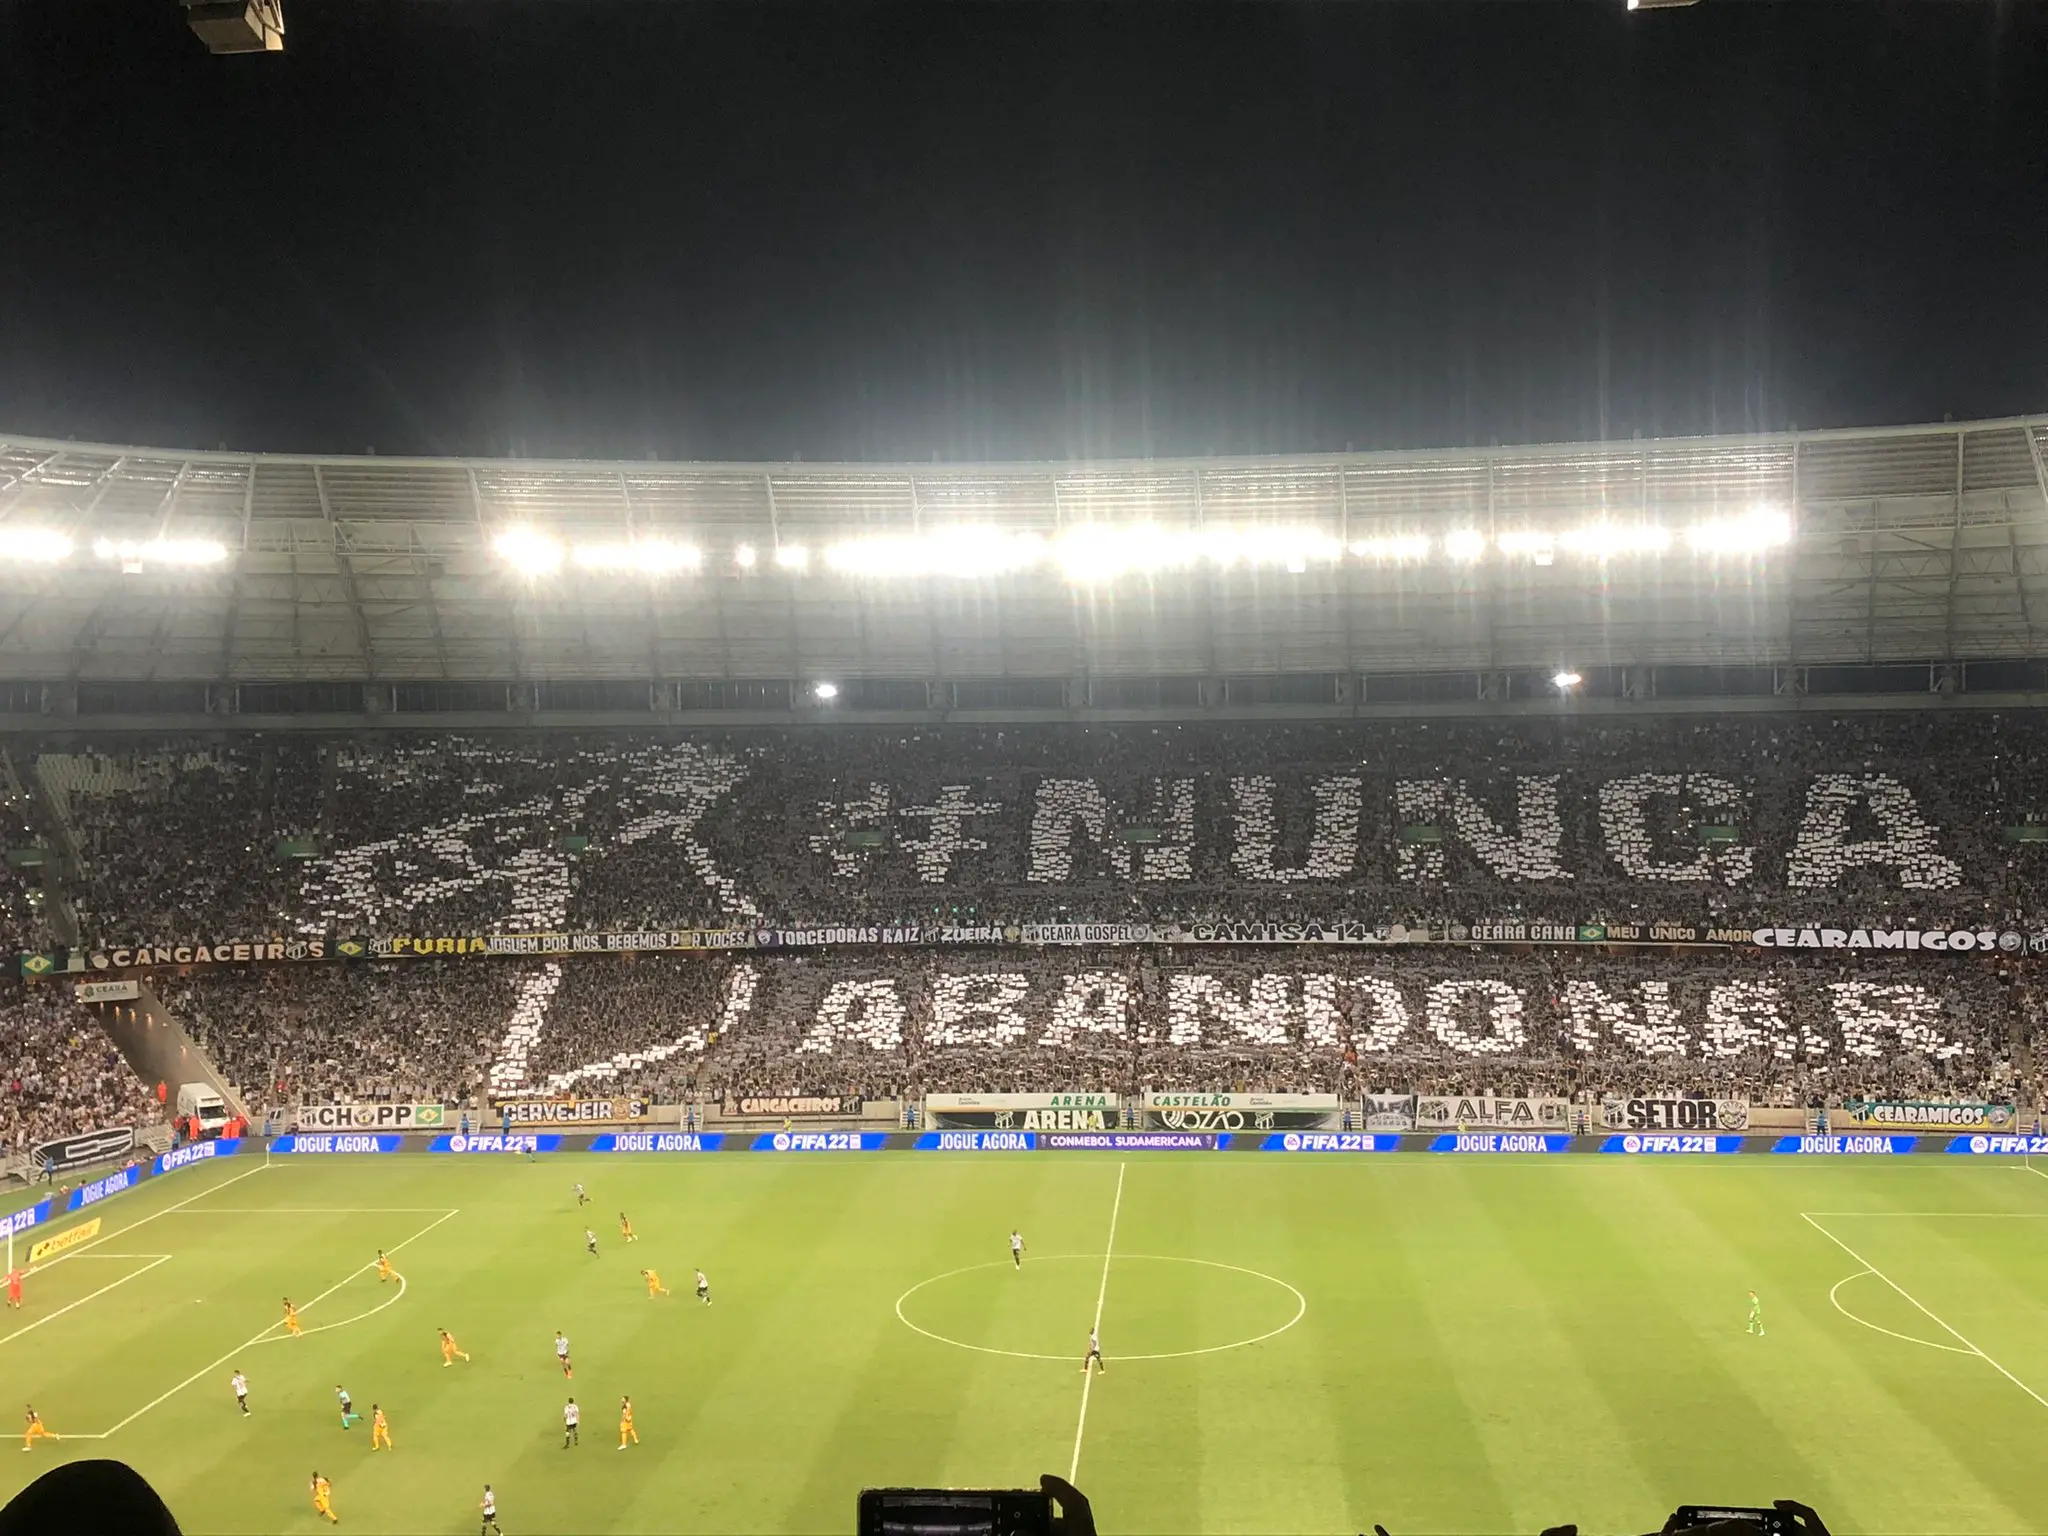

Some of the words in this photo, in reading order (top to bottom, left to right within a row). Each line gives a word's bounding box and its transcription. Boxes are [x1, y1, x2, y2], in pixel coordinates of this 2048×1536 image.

[776, 927, 878, 945] TORCEDORAS
[941, 926, 1003, 942] ZUEIRA
[1085, 925, 1130, 940] GOSPEL
[1192, 923, 1325, 942] CAMISA
[1332, 923, 1367, 942] 14
[1531, 925, 1576, 940] CANA
[1607, 926, 1640, 939] MEU
[1706, 928, 1752, 942] AMOR
[1752, 928, 1997, 950] CEARAMIGOS
[487, 936, 542, 952] JOGUEM
[543, 935, 568, 950] POR
[607, 933, 666, 950] BEBEMOS
[741, 1098, 840, 1113] CANGACEIROS
[1050, 1095, 1107, 1106] ARENA
[1153, 1094, 1231, 1107] CASTELÃO
[1455, 1099, 1534, 1121] ALFA
[1627, 1100, 1717, 1129] SETOR
[1872, 1105, 1985, 1125] CEARAMIGOS
[1023, 1110, 1106, 1130] ARENA
[291, 1136, 333, 1152] JOGUE
[335, 1136, 379, 1152] AGORA
[467, 1136, 503, 1150] FIFA
[504, 1136, 523, 1150] 22
[612, 1135, 654, 1151] JOGUE
[657, 1135, 702, 1151] AGORA
[791, 1135, 826, 1149] FIFA
[827, 1135, 849, 1149] 22
[937, 1134, 979, 1150] JOGUE
[981, 1134, 1027, 1150] AGORA
[1050, 1135, 1112, 1146] CONMEBOL
[1115, 1135, 1201, 1147] SUDAMERICANA
[1302, 1135, 1339, 1149] FIFA
[1340, 1135, 1361, 1149] 22
[1453, 1136, 1498, 1152] JOGUE
[1500, 1136, 1548, 1152] AGORA
[1641, 1137, 1680, 1151] FIFA
[1681, 1137, 1703, 1151] 22
[1797, 1137, 1842, 1153] JOGUE
[1845, 1137, 1893, 1153] AGORA
[1989, 1137, 2028, 1152] FIFA
[171, 1147, 193, 1168] FIFA
[192, 1144, 205, 1161] 22
[81, 1182, 104, 1206] JOGUE
[105, 1171, 129, 1195] AGORA
[14, 1210, 27, 1232] 22
